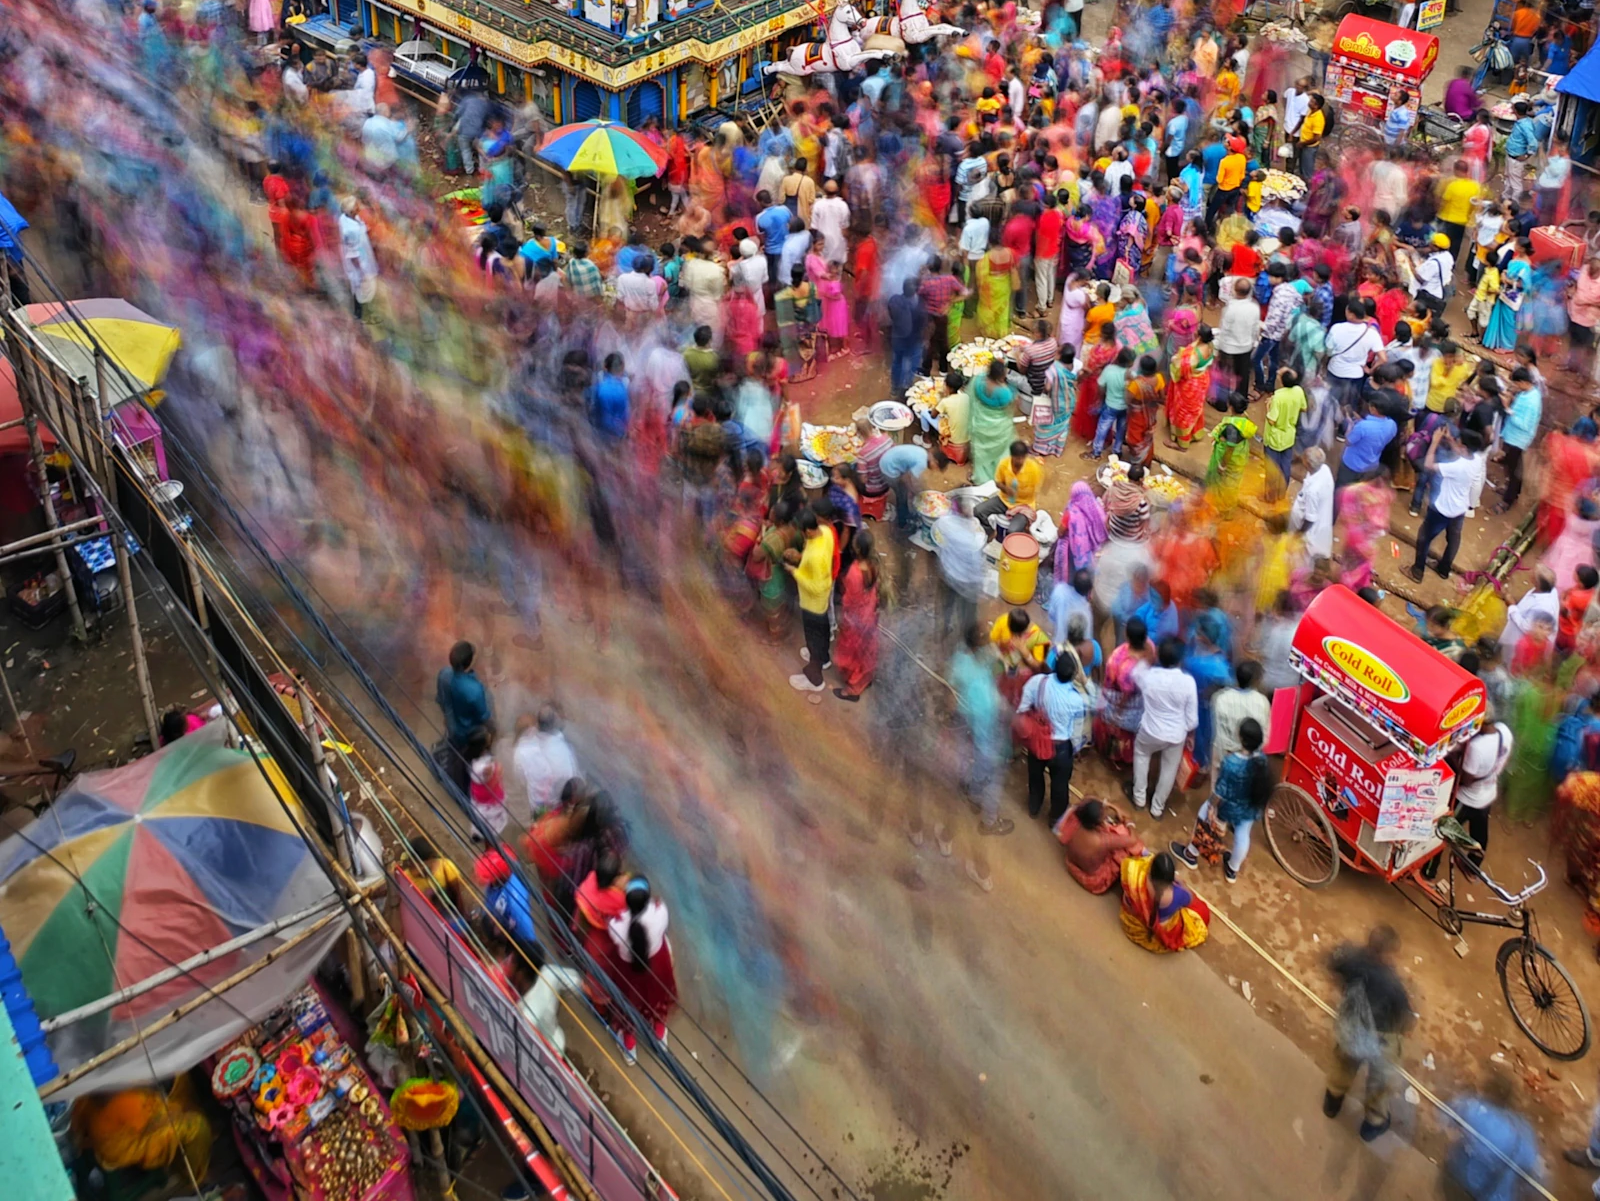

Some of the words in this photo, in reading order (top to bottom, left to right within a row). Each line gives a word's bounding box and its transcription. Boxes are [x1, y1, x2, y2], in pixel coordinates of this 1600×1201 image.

[1331, 642, 1362, 670] Cold
[1363, 666, 1393, 692] Roll
[1365, 690, 1378, 705] Milk
[1378, 701, 1405, 725] Products
[1307, 727, 1348, 770] Cold
[1350, 761, 1384, 799] Rol
[1310, 744, 1323, 758] The
[1325, 757, 1344, 777] Taste
[1381, 752, 1407, 771] Cold
